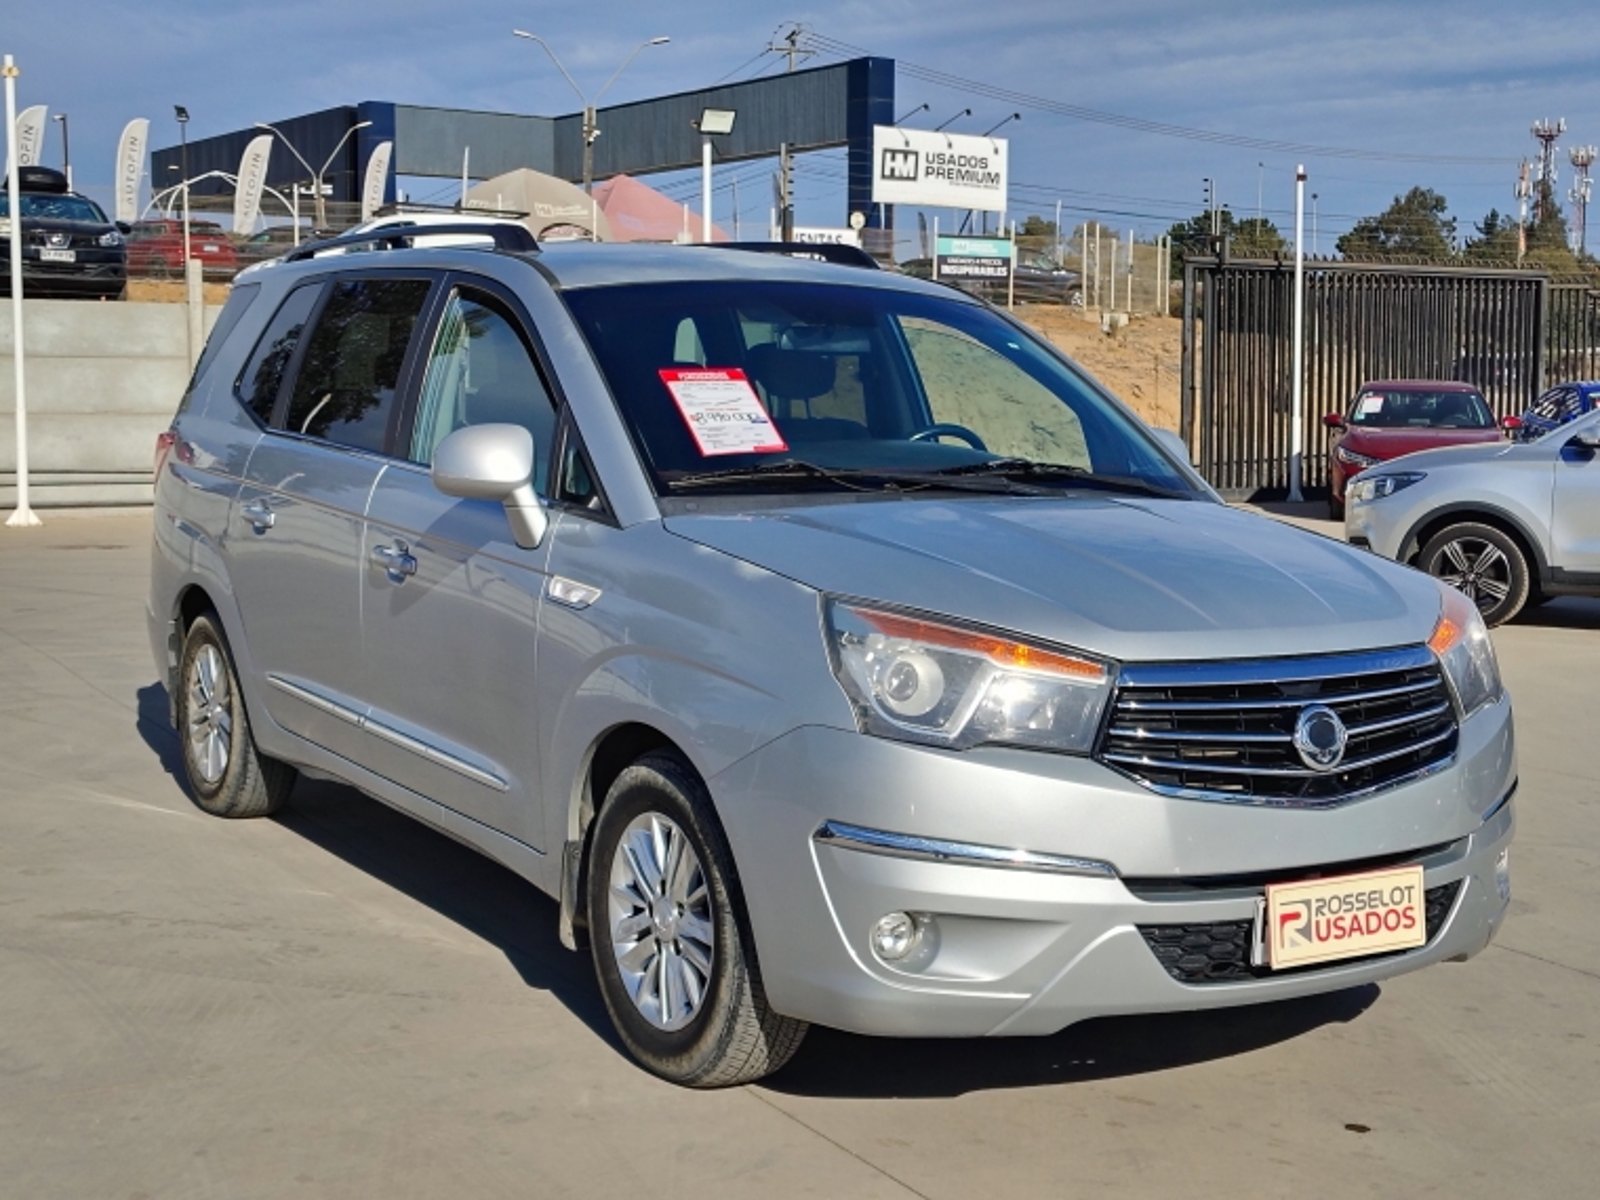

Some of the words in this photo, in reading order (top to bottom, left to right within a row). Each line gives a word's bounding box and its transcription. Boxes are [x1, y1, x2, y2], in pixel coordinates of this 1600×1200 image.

[126, 136, 138, 205] AUTOFIN
[925, 152, 988, 169] USADOS
[925, 166, 1000, 184] PREMIUM
[243, 152, 262, 217] AUTOFIN
[1315, 886, 1415, 917] ROSSELOT
[1315, 906, 1416, 942] USADOS
